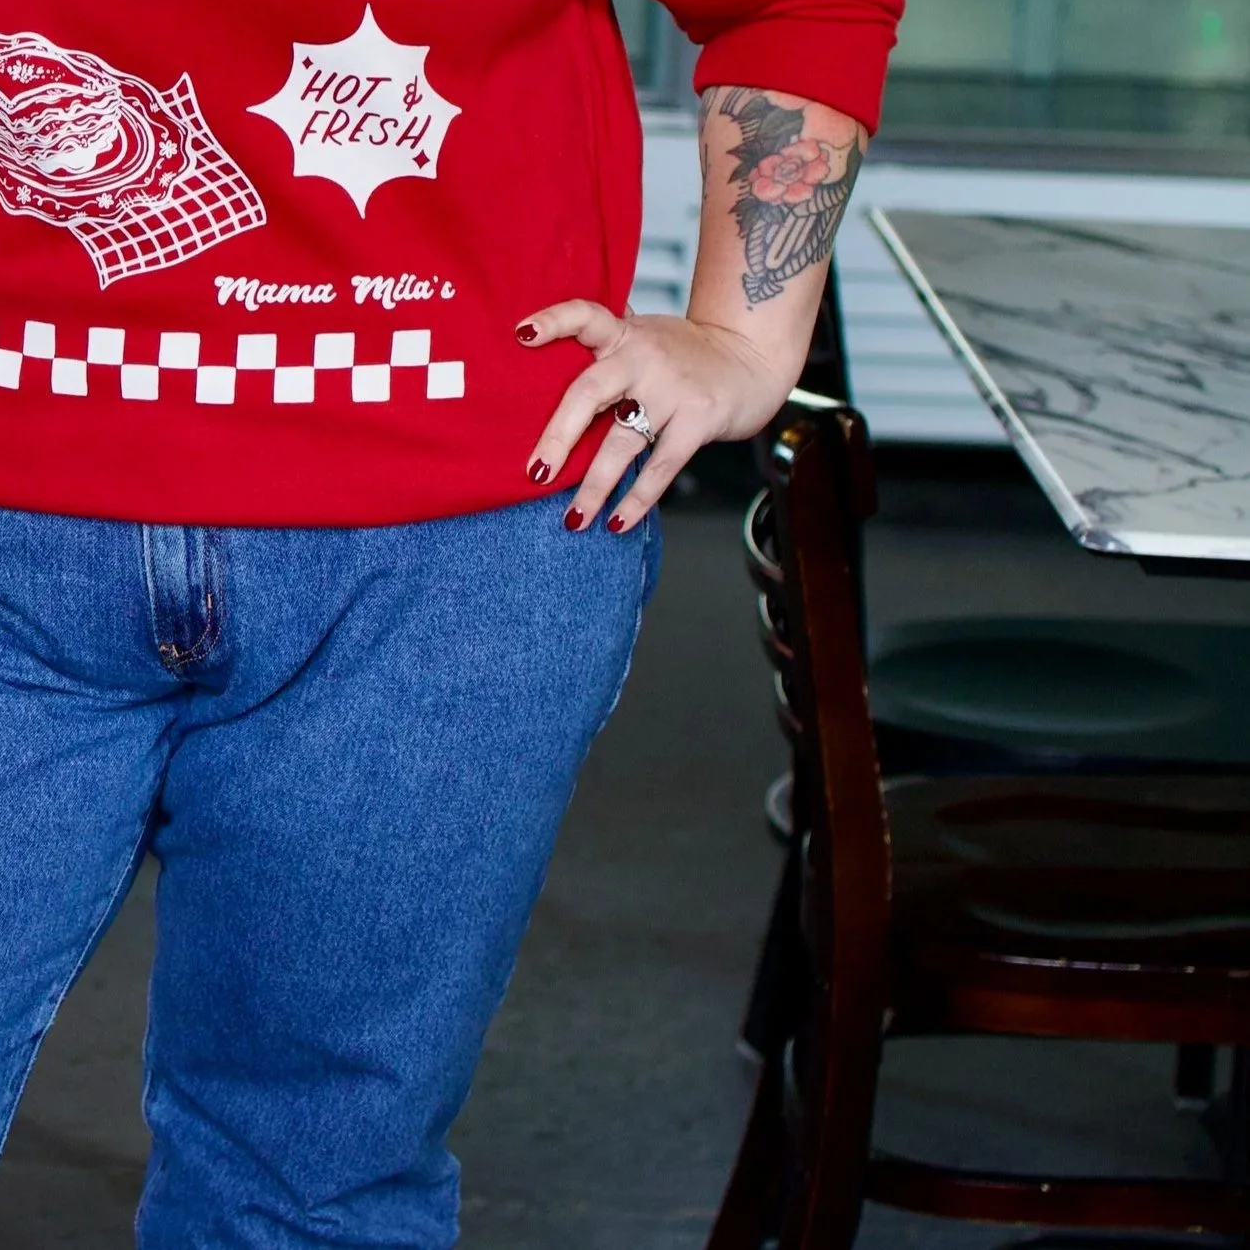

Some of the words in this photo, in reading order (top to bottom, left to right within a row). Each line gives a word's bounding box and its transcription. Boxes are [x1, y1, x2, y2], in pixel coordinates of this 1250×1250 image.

[300, 69, 392, 108] HOT
[402, 75, 423, 113] &
[299, 108, 432, 149] FRESH
[214, 274, 337, 312] Mama
[350, 273, 456, 310] Mila's
